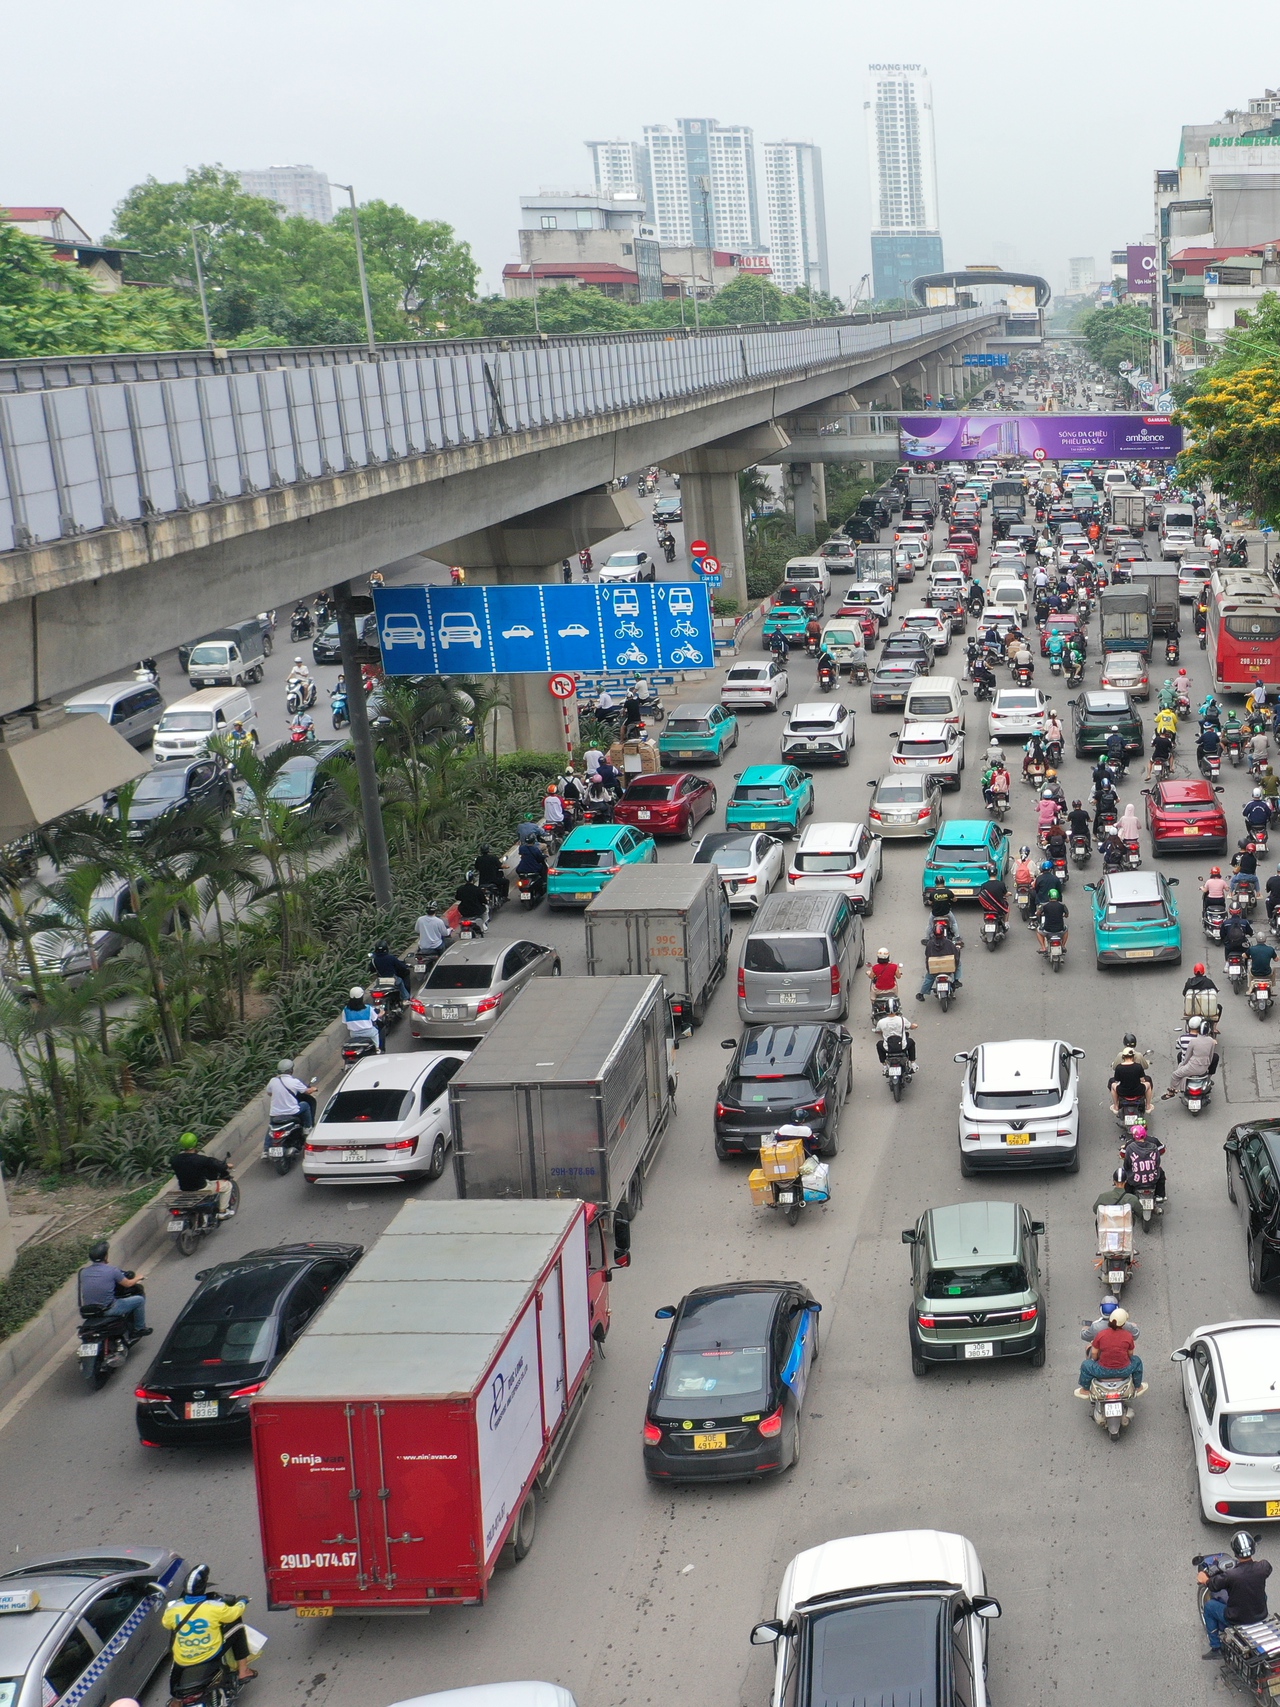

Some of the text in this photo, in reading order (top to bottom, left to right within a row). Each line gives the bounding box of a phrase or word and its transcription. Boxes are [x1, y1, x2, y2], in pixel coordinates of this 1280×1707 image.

[739, 256, 770, 266] HOTEL
[1126, 434, 1164, 442] ambience
[656, 936, 676, 944] 99C
[192, 1408, 218, 1418] 183.65
[698, 1442, 723, 1450] 491.72
[291, 1454, 344, 1466] ninjavan
[280, 1552, 357, 1569] 29LD-074.67
[176, 1614, 208, 1636] be
[178, 1634, 211, 1647] Food
